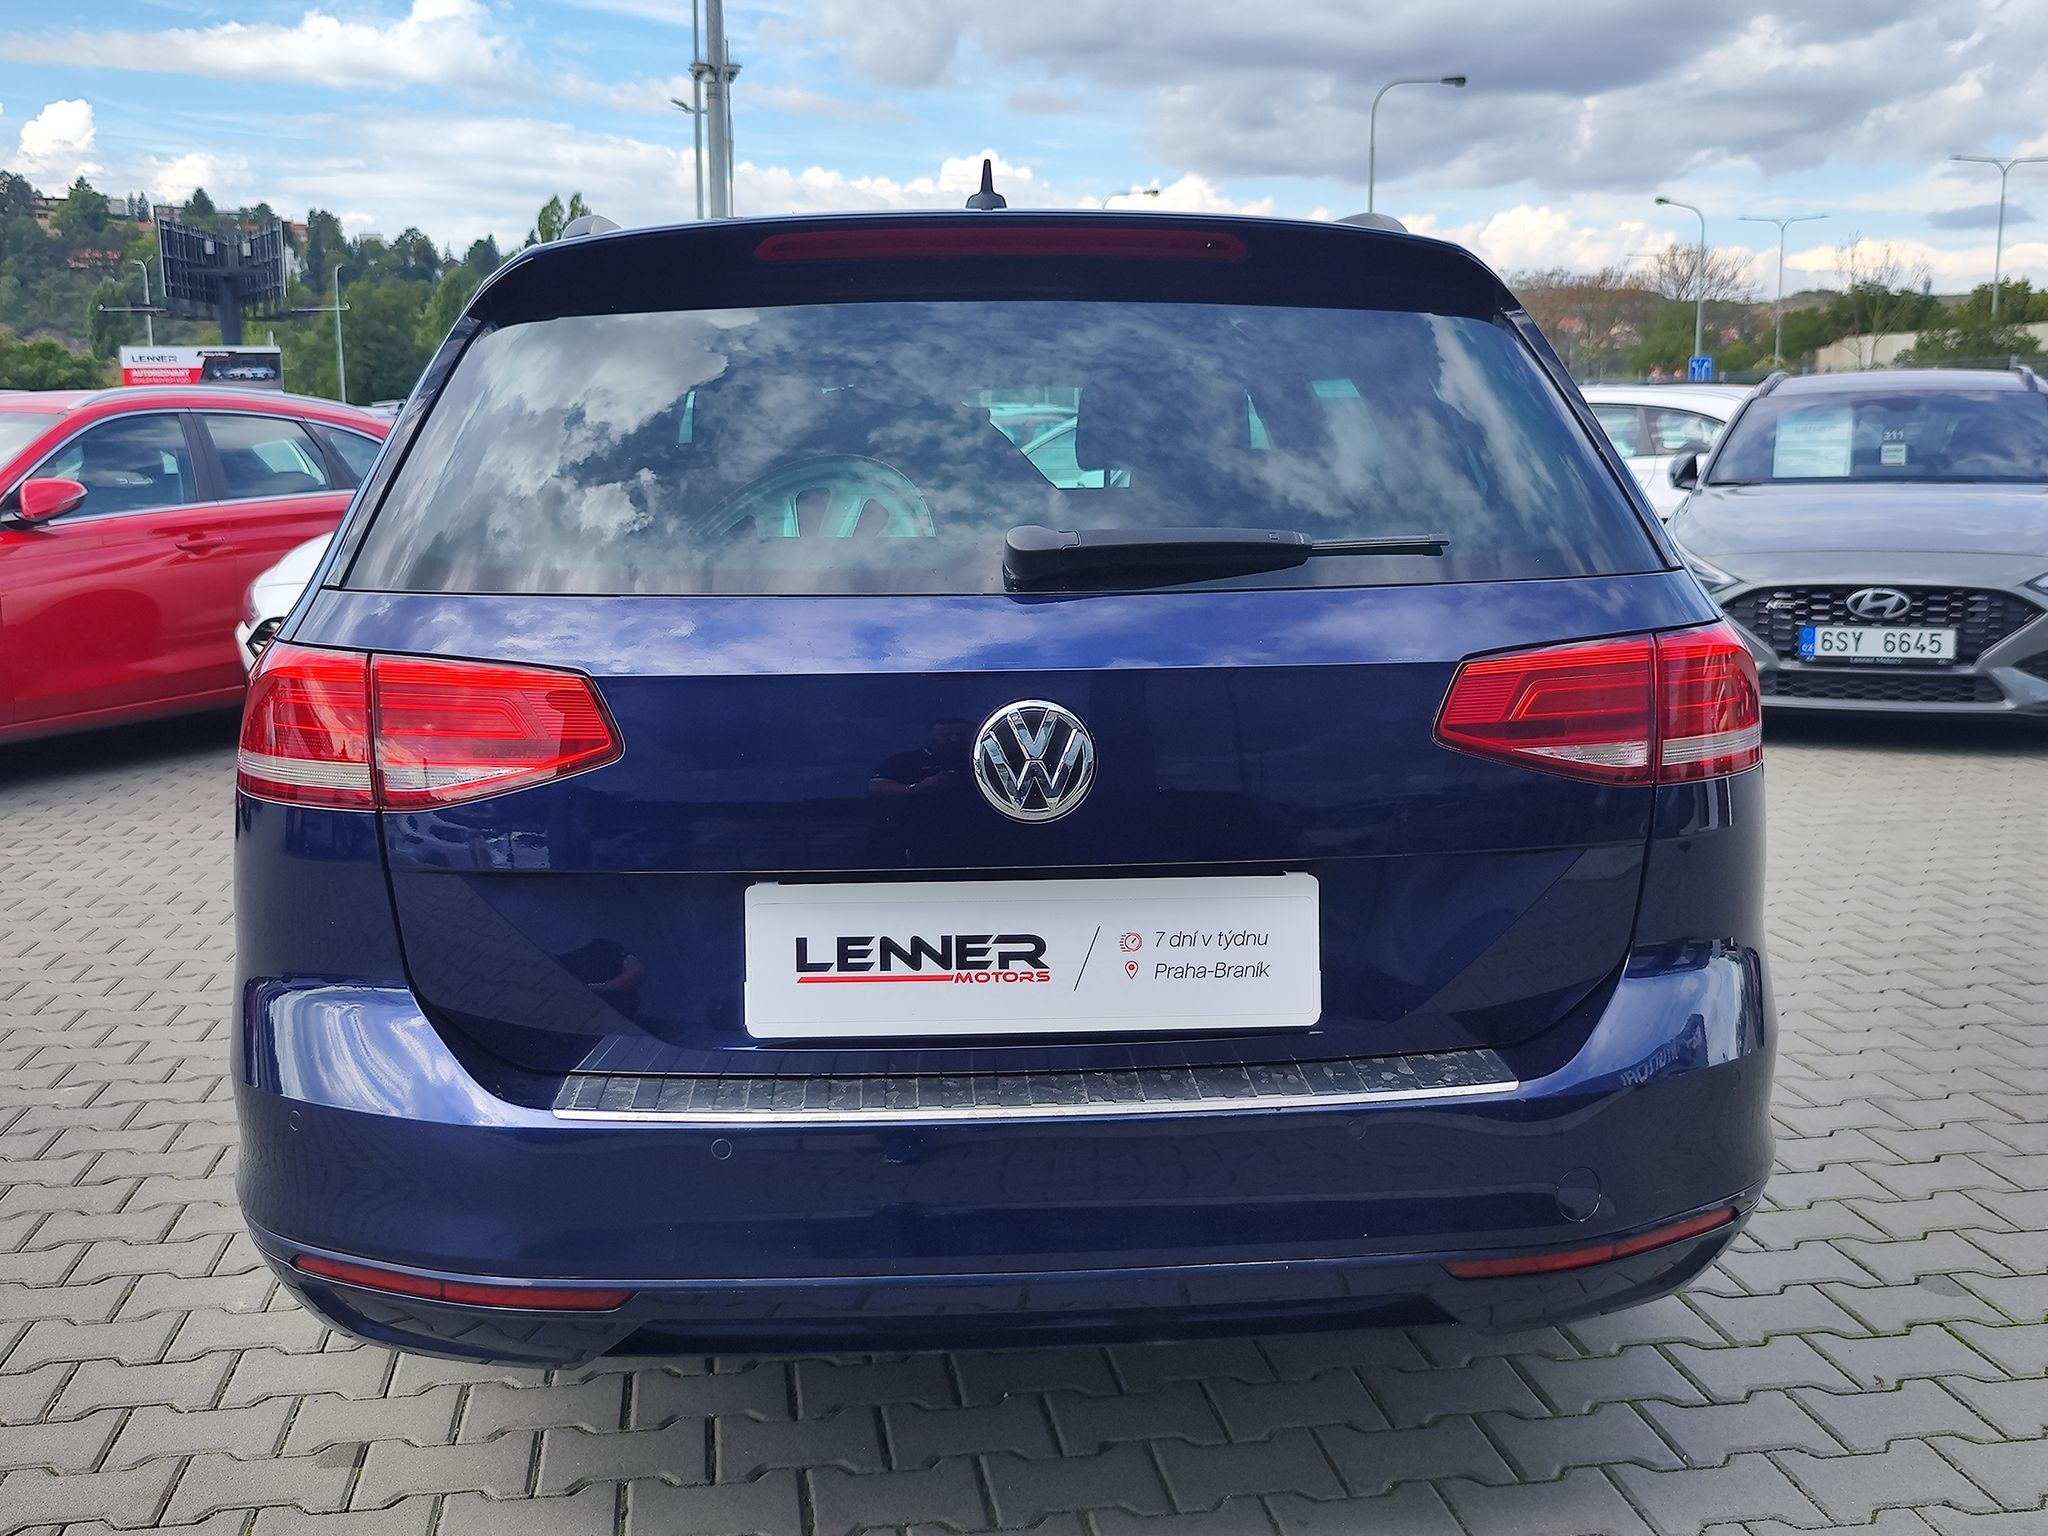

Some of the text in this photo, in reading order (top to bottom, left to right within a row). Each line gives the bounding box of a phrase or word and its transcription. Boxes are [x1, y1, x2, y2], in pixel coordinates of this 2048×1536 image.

[1821, 631, 1942, 653] 6SY 6645
[1155, 930, 1269, 951] 7 dní v týdnu
[796, 934, 1050, 973] LENNER
[954, 970, 1051, 984] MOTORS
[1154, 961, 1271, 980] Praha-Braník
